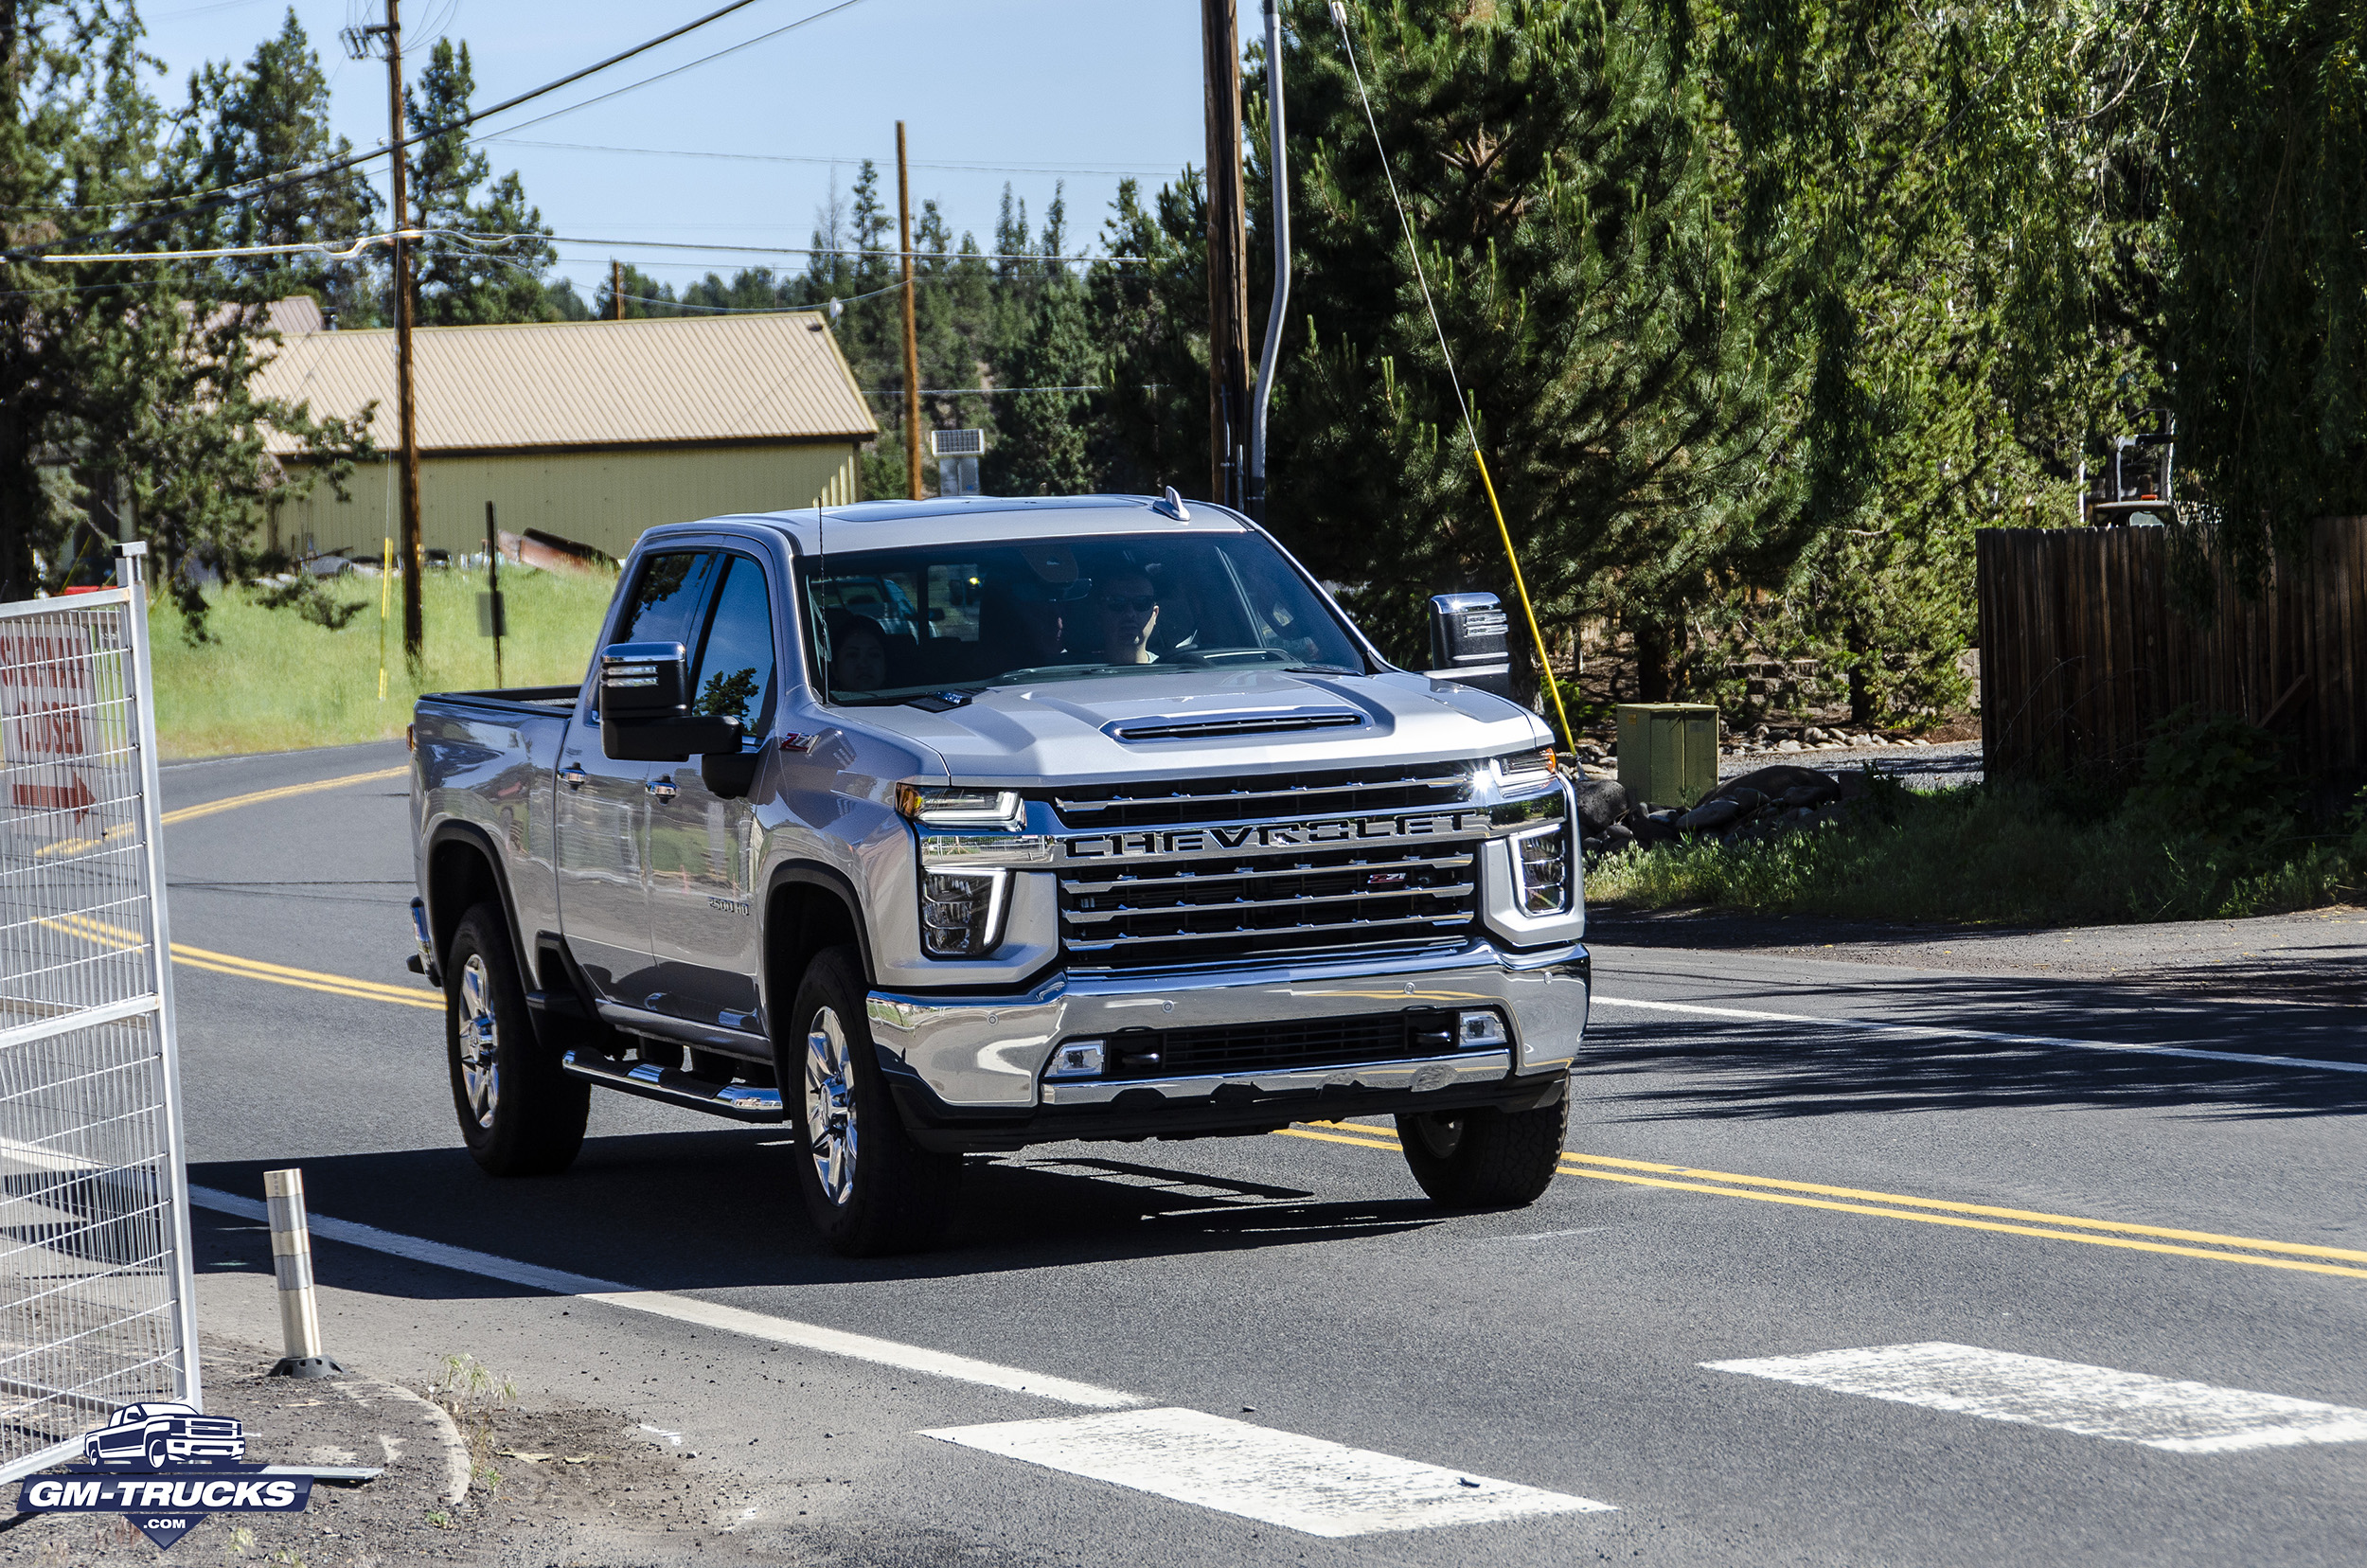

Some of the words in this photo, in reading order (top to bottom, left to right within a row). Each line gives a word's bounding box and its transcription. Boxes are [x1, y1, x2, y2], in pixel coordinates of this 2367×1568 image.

[17, 700, 83, 755] CLOSED
[780, 731, 820, 754] Z71
[1064, 810, 1477, 858] CHEVROLET
[1367, 872, 1406, 884] Z71
[708, 897, 734, 912] 2500
[736, 901, 750, 916] HD
